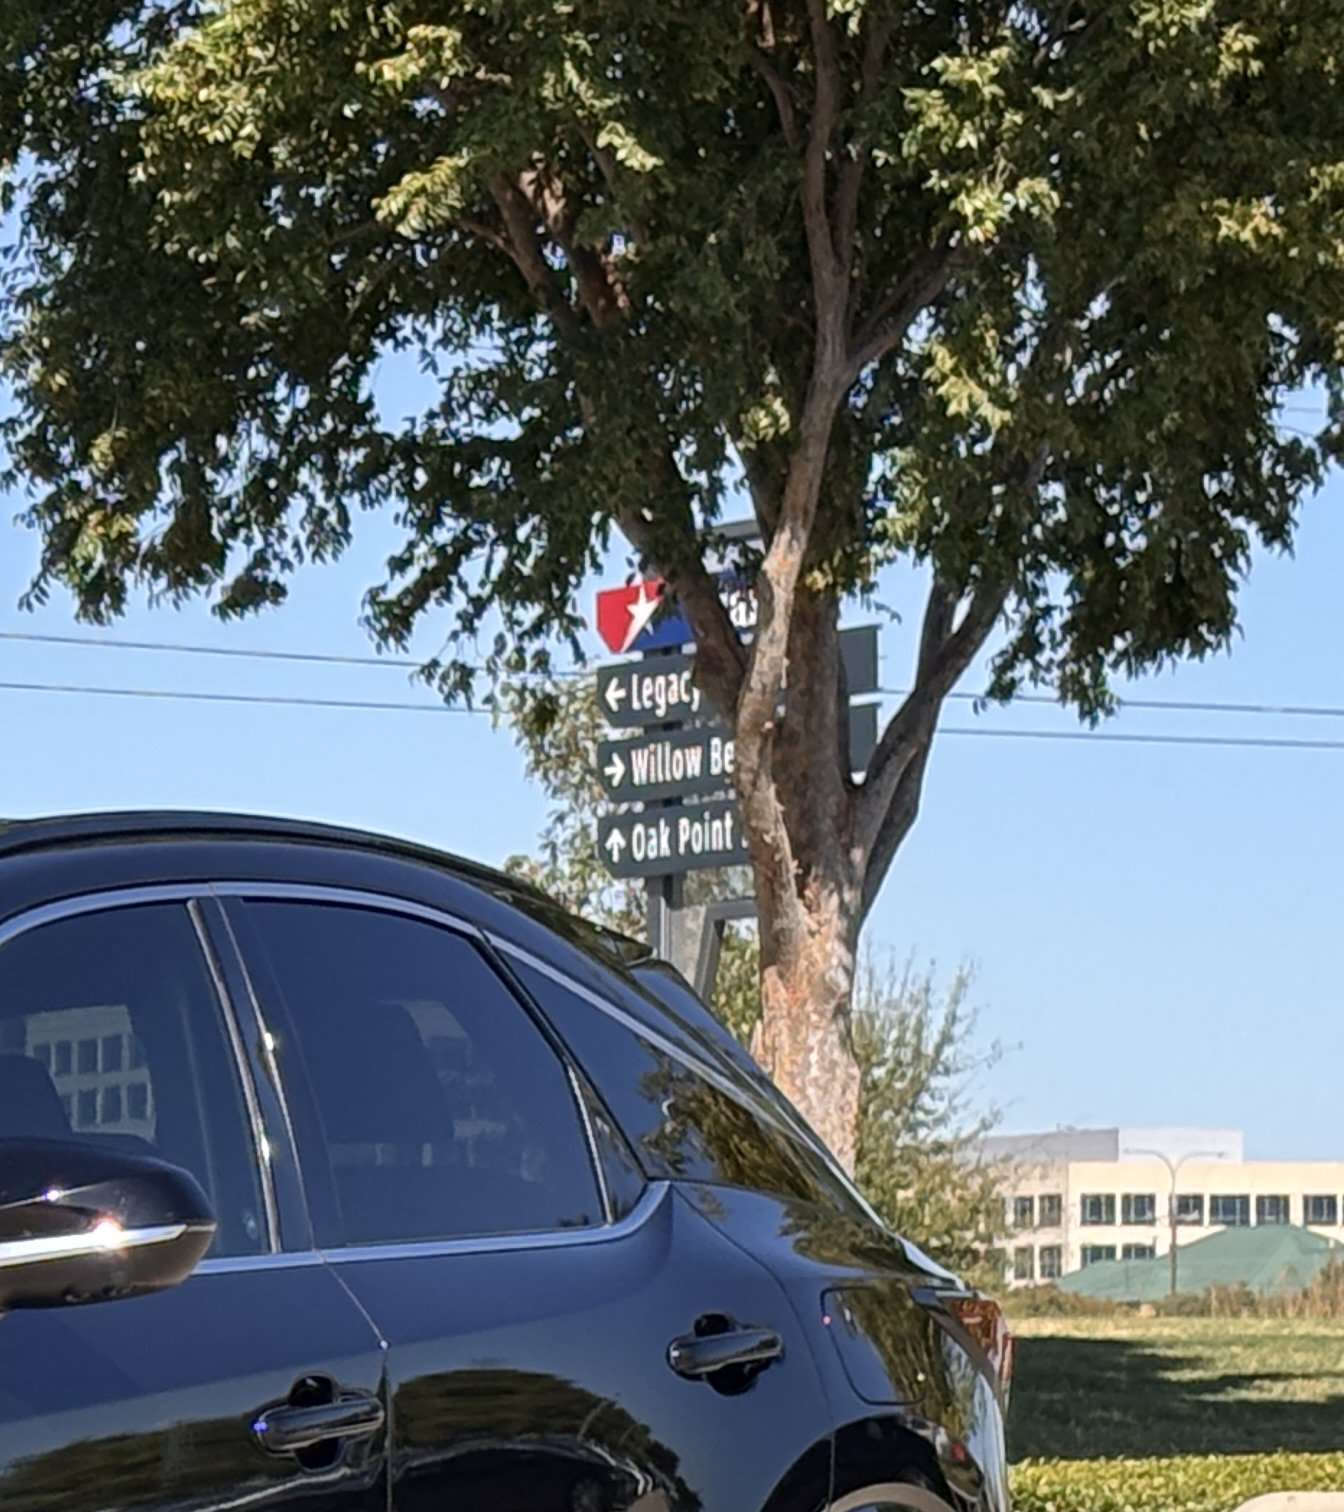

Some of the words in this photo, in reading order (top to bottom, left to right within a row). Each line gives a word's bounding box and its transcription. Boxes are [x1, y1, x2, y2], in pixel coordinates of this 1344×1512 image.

[631, 741, 703, 786] Willow
[632, 817, 671, 861] Oak
[678, 810, 733, 855] Point
